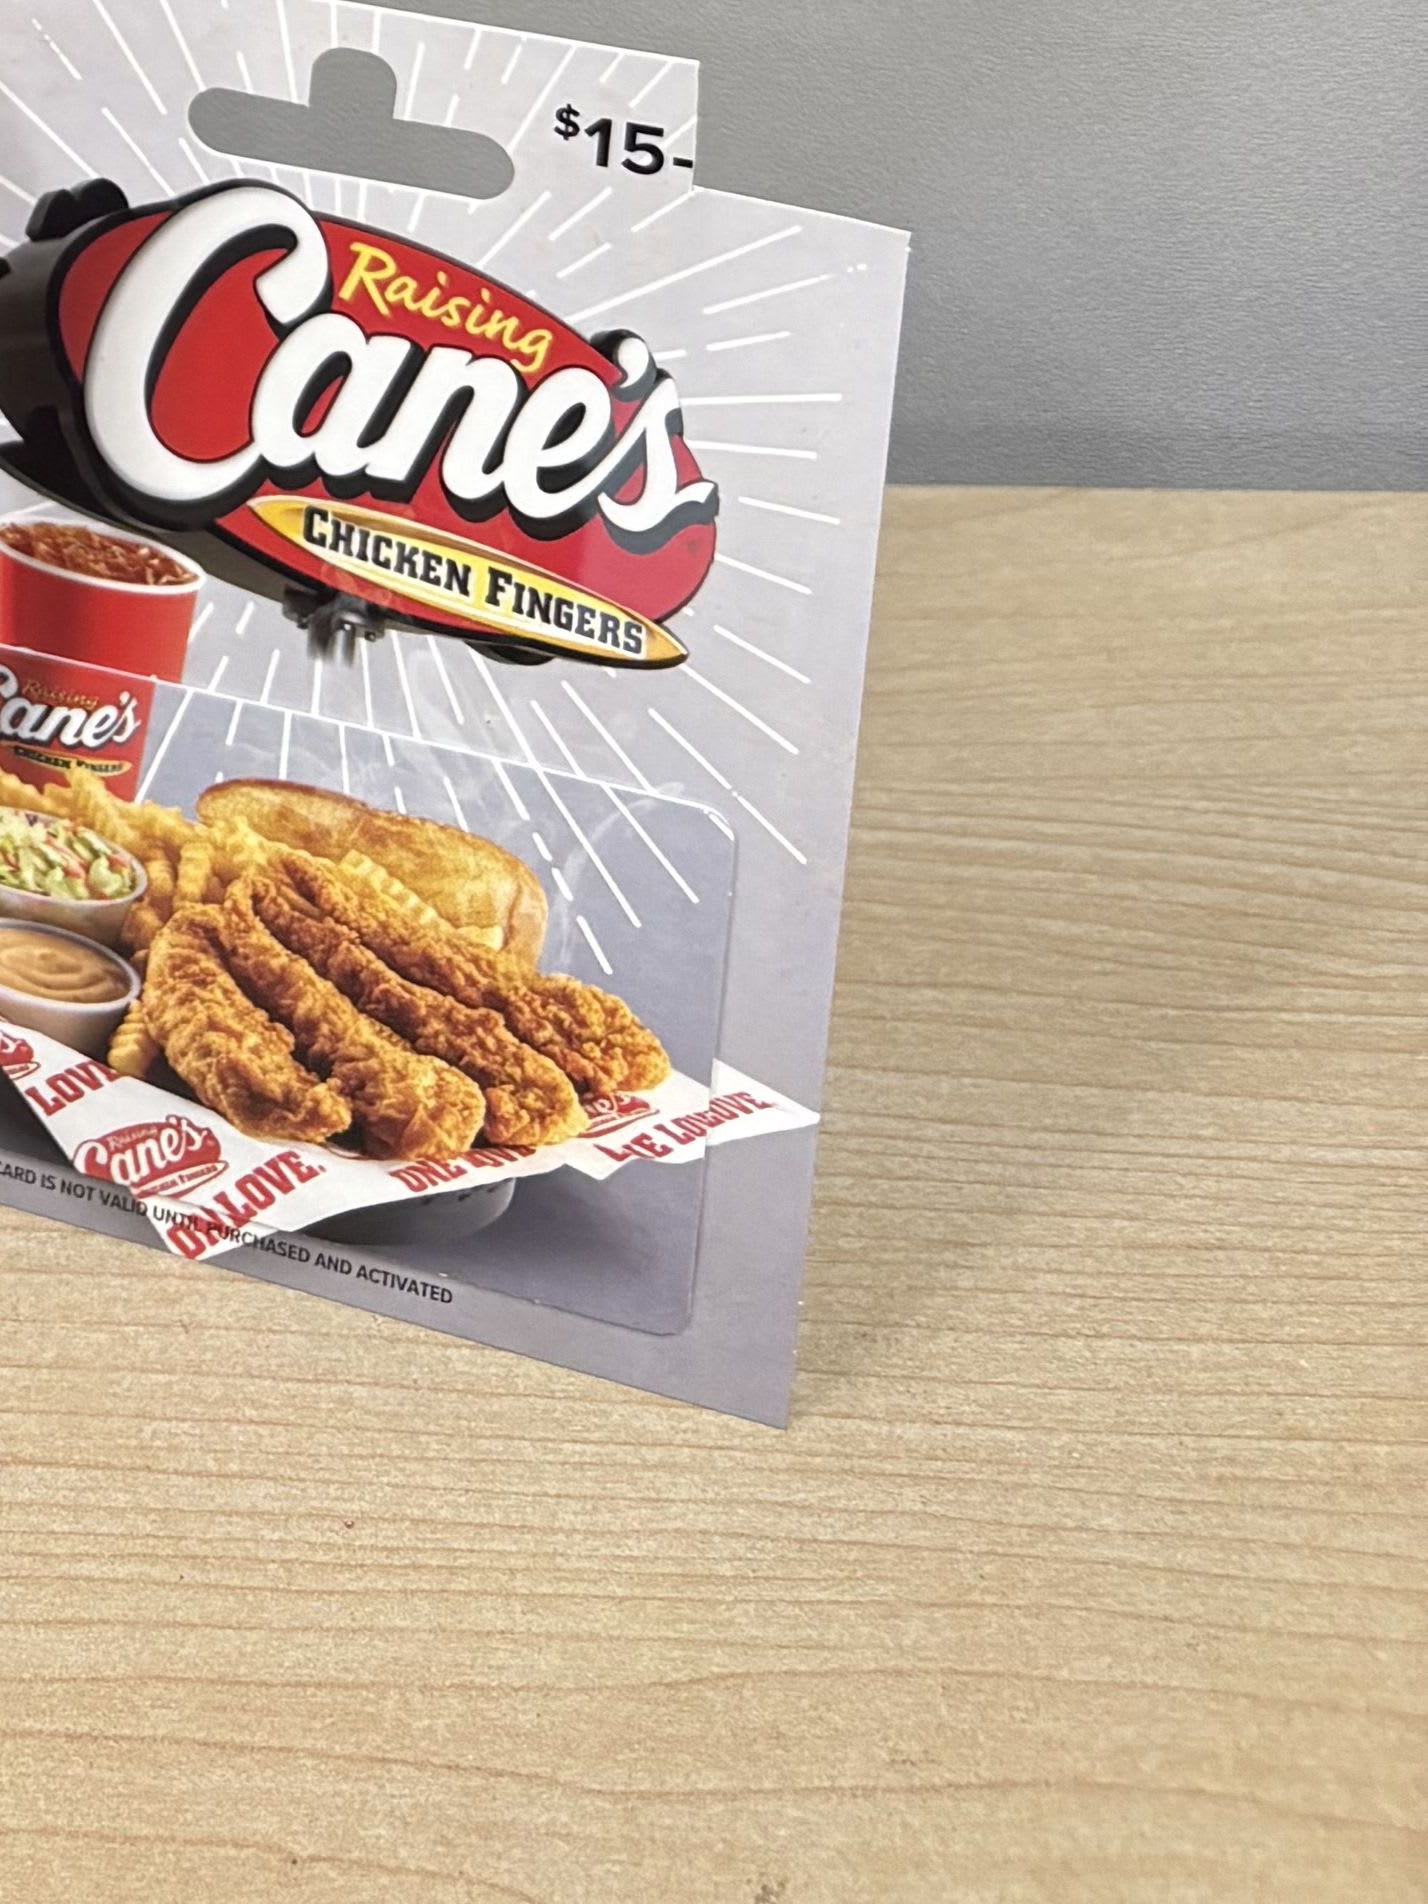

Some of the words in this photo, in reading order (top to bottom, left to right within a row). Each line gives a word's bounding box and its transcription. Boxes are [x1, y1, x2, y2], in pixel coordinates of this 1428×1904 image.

[85, 185, 717, 532] Cane's
[339, 242, 553, 373] Raising
[302, 505, 474, 596] CHICKEN
[486, 570, 646, 656] FINGERS
[74, 1115, 208, 1188] Cane's
[41, 1174, 57, 1191] IS
[61, 1179, 95, 1201] NOT
[98, 1191, 148, 1217] VALID
[207, 1220, 311, 1264] PURCHASED
[315, 1253, 352, 1276] AND
[356, 1265, 454, 1304] ACTIVATED
